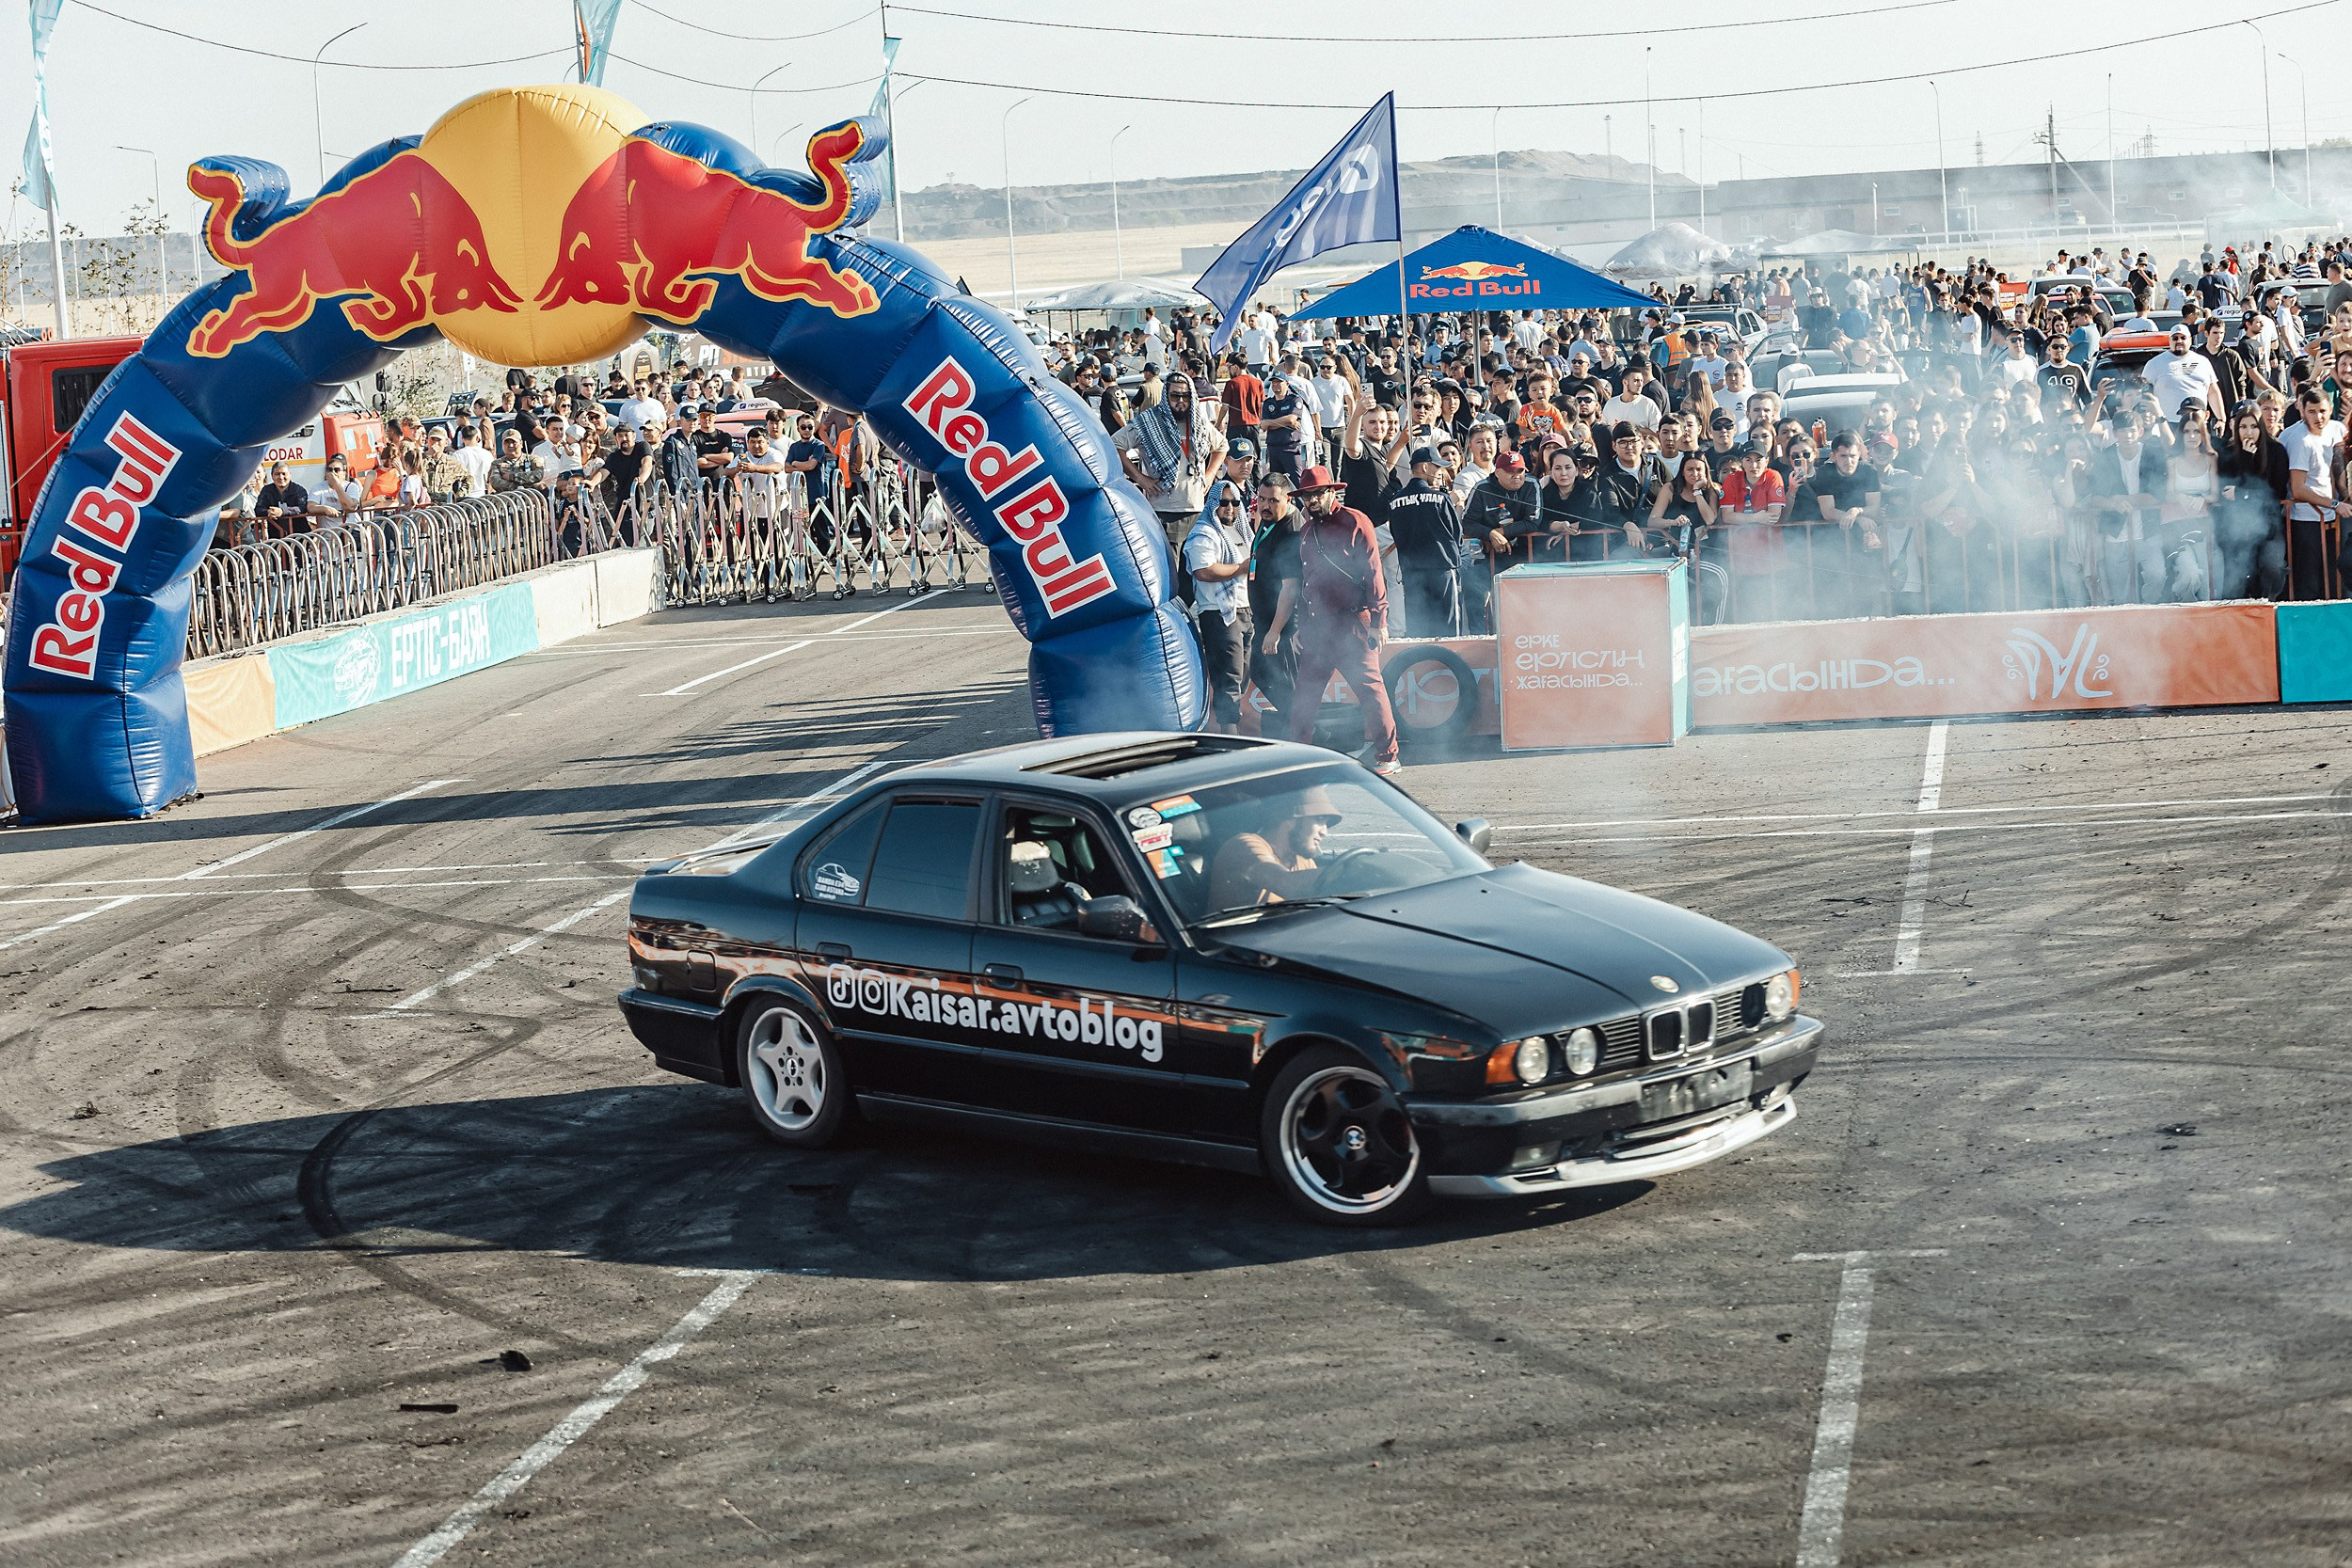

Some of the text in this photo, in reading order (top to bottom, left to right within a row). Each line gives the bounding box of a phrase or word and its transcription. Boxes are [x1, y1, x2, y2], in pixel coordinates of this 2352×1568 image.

[1409, 279, 1541, 298] Red Bull
[264, 447, 304, 462] LODAR
[903, 357, 1115, 617] Red Bull
[30, 412, 180, 678] Red Bull
[391, 601, 491, 689] ЕРТІС-БАЯН
[1692, 656, 1955, 697] ағасында...
[890, 972, 1164, 1063] Kaisar.avtoblog
